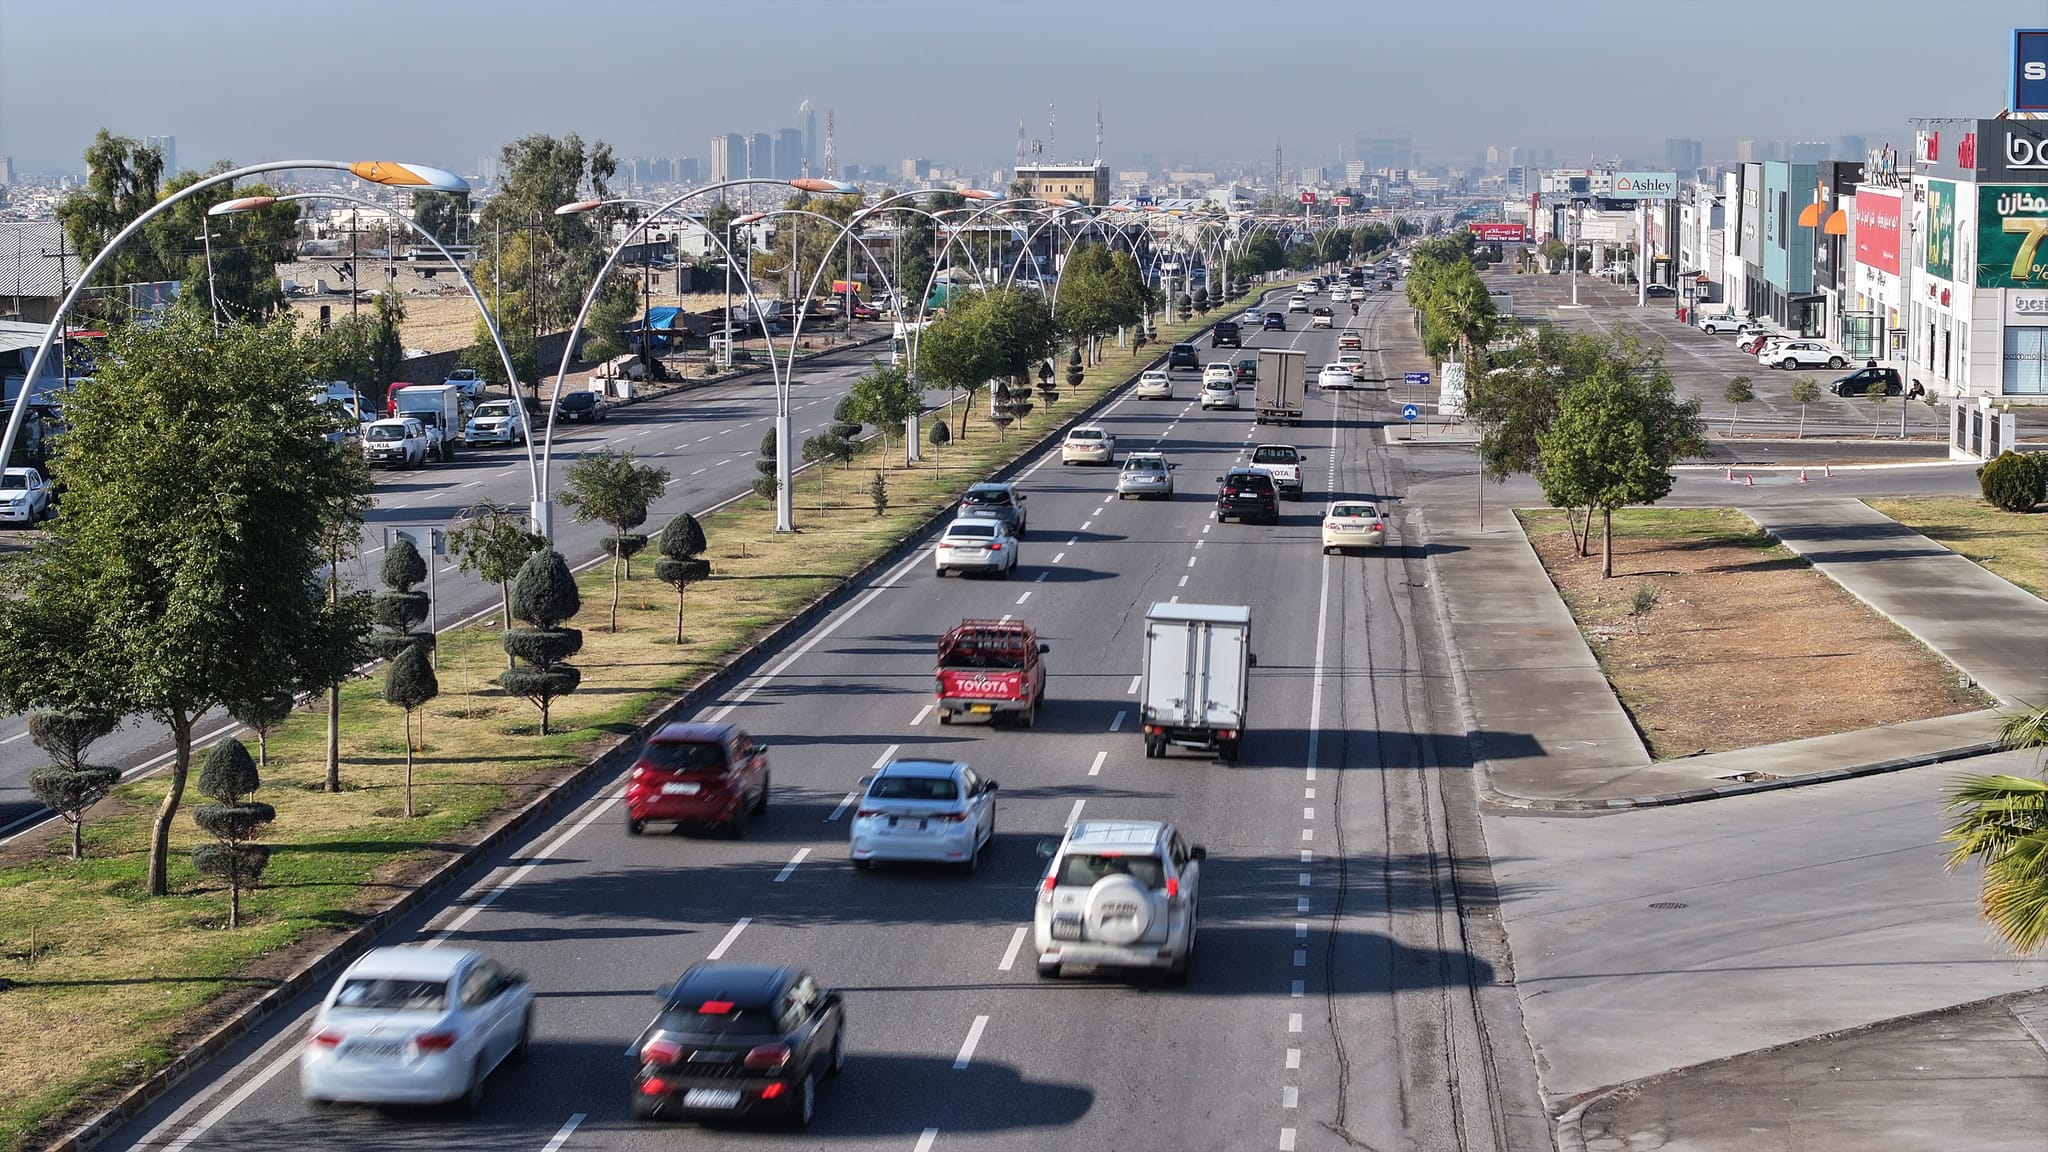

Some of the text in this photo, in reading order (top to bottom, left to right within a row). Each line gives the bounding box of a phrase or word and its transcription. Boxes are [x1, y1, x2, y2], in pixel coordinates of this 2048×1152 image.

[2024, 62, 2048, 80] S
[1632, 179, 1672, 193] Ashley
[1997, 192, 2048, 215] مخازن
[2002, 217, 2048, 280] 7
[956, 680, 1008, 693] TOYOTA
